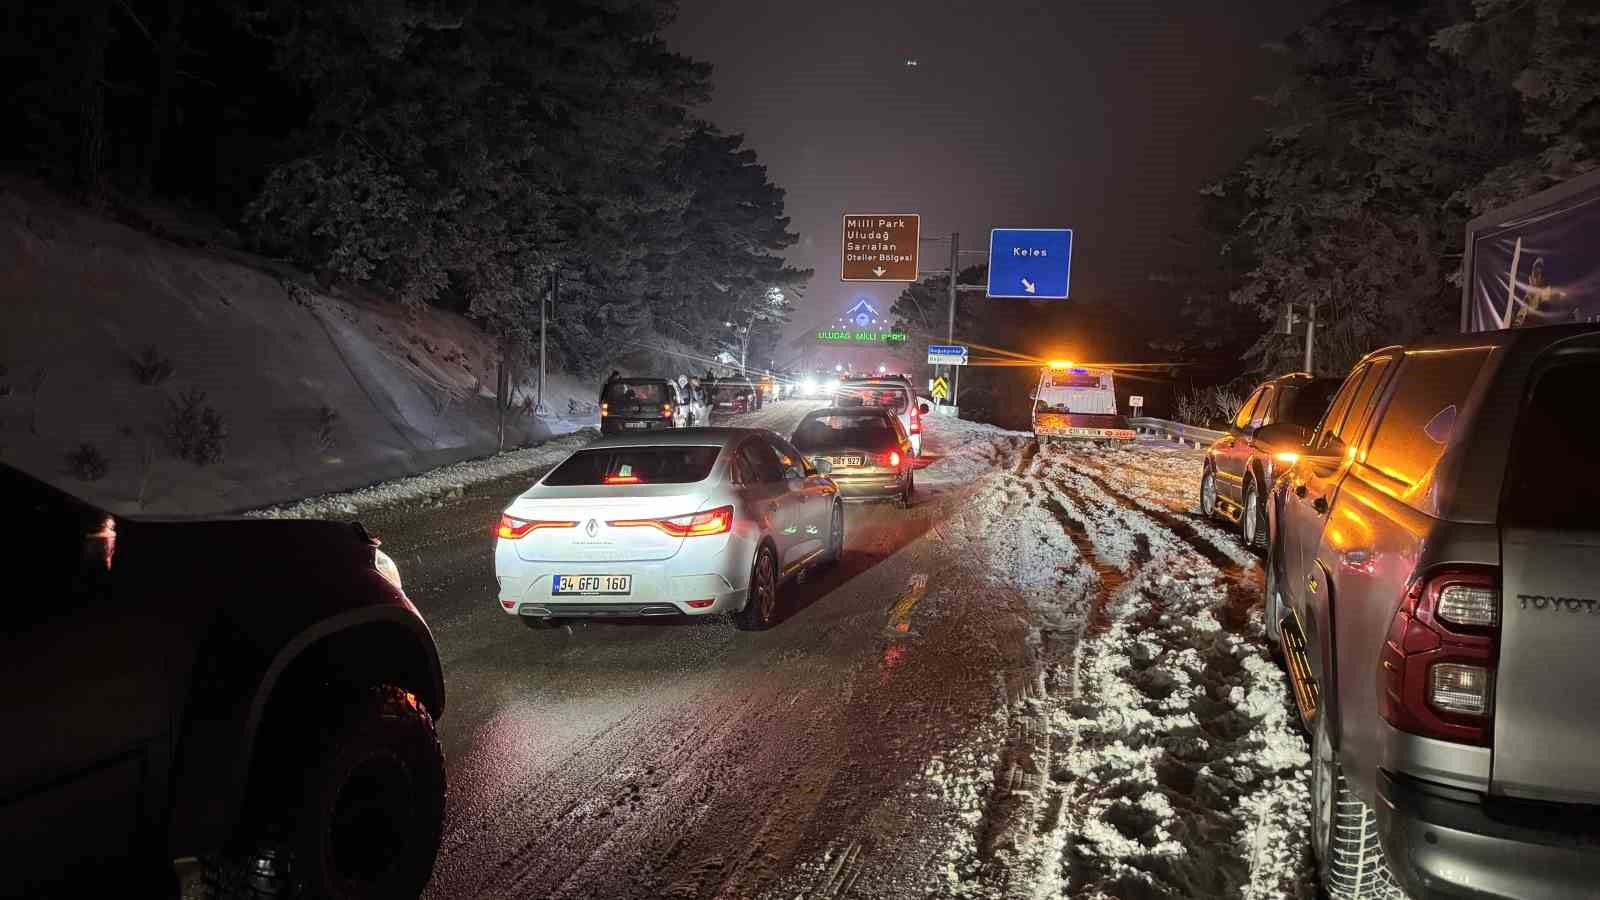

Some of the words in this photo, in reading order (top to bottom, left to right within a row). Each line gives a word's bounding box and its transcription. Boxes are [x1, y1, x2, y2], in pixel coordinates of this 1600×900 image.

[847, 219, 874, 228] Milli
[878, 218, 905, 228] Park
[847, 230, 889, 241] Uludağ
[847, 242, 897, 251] Sarıalan
[1013, 247, 1048, 257] Keles
[847, 253, 877, 262] Oteller
[879, 253, 913, 263] Bölgesi
[561, 577, 574, 591] 34
[579, 577, 600, 591] GFD
[606, 577, 627, 591] 160
[1517, 593, 1600, 615] TOYOT
